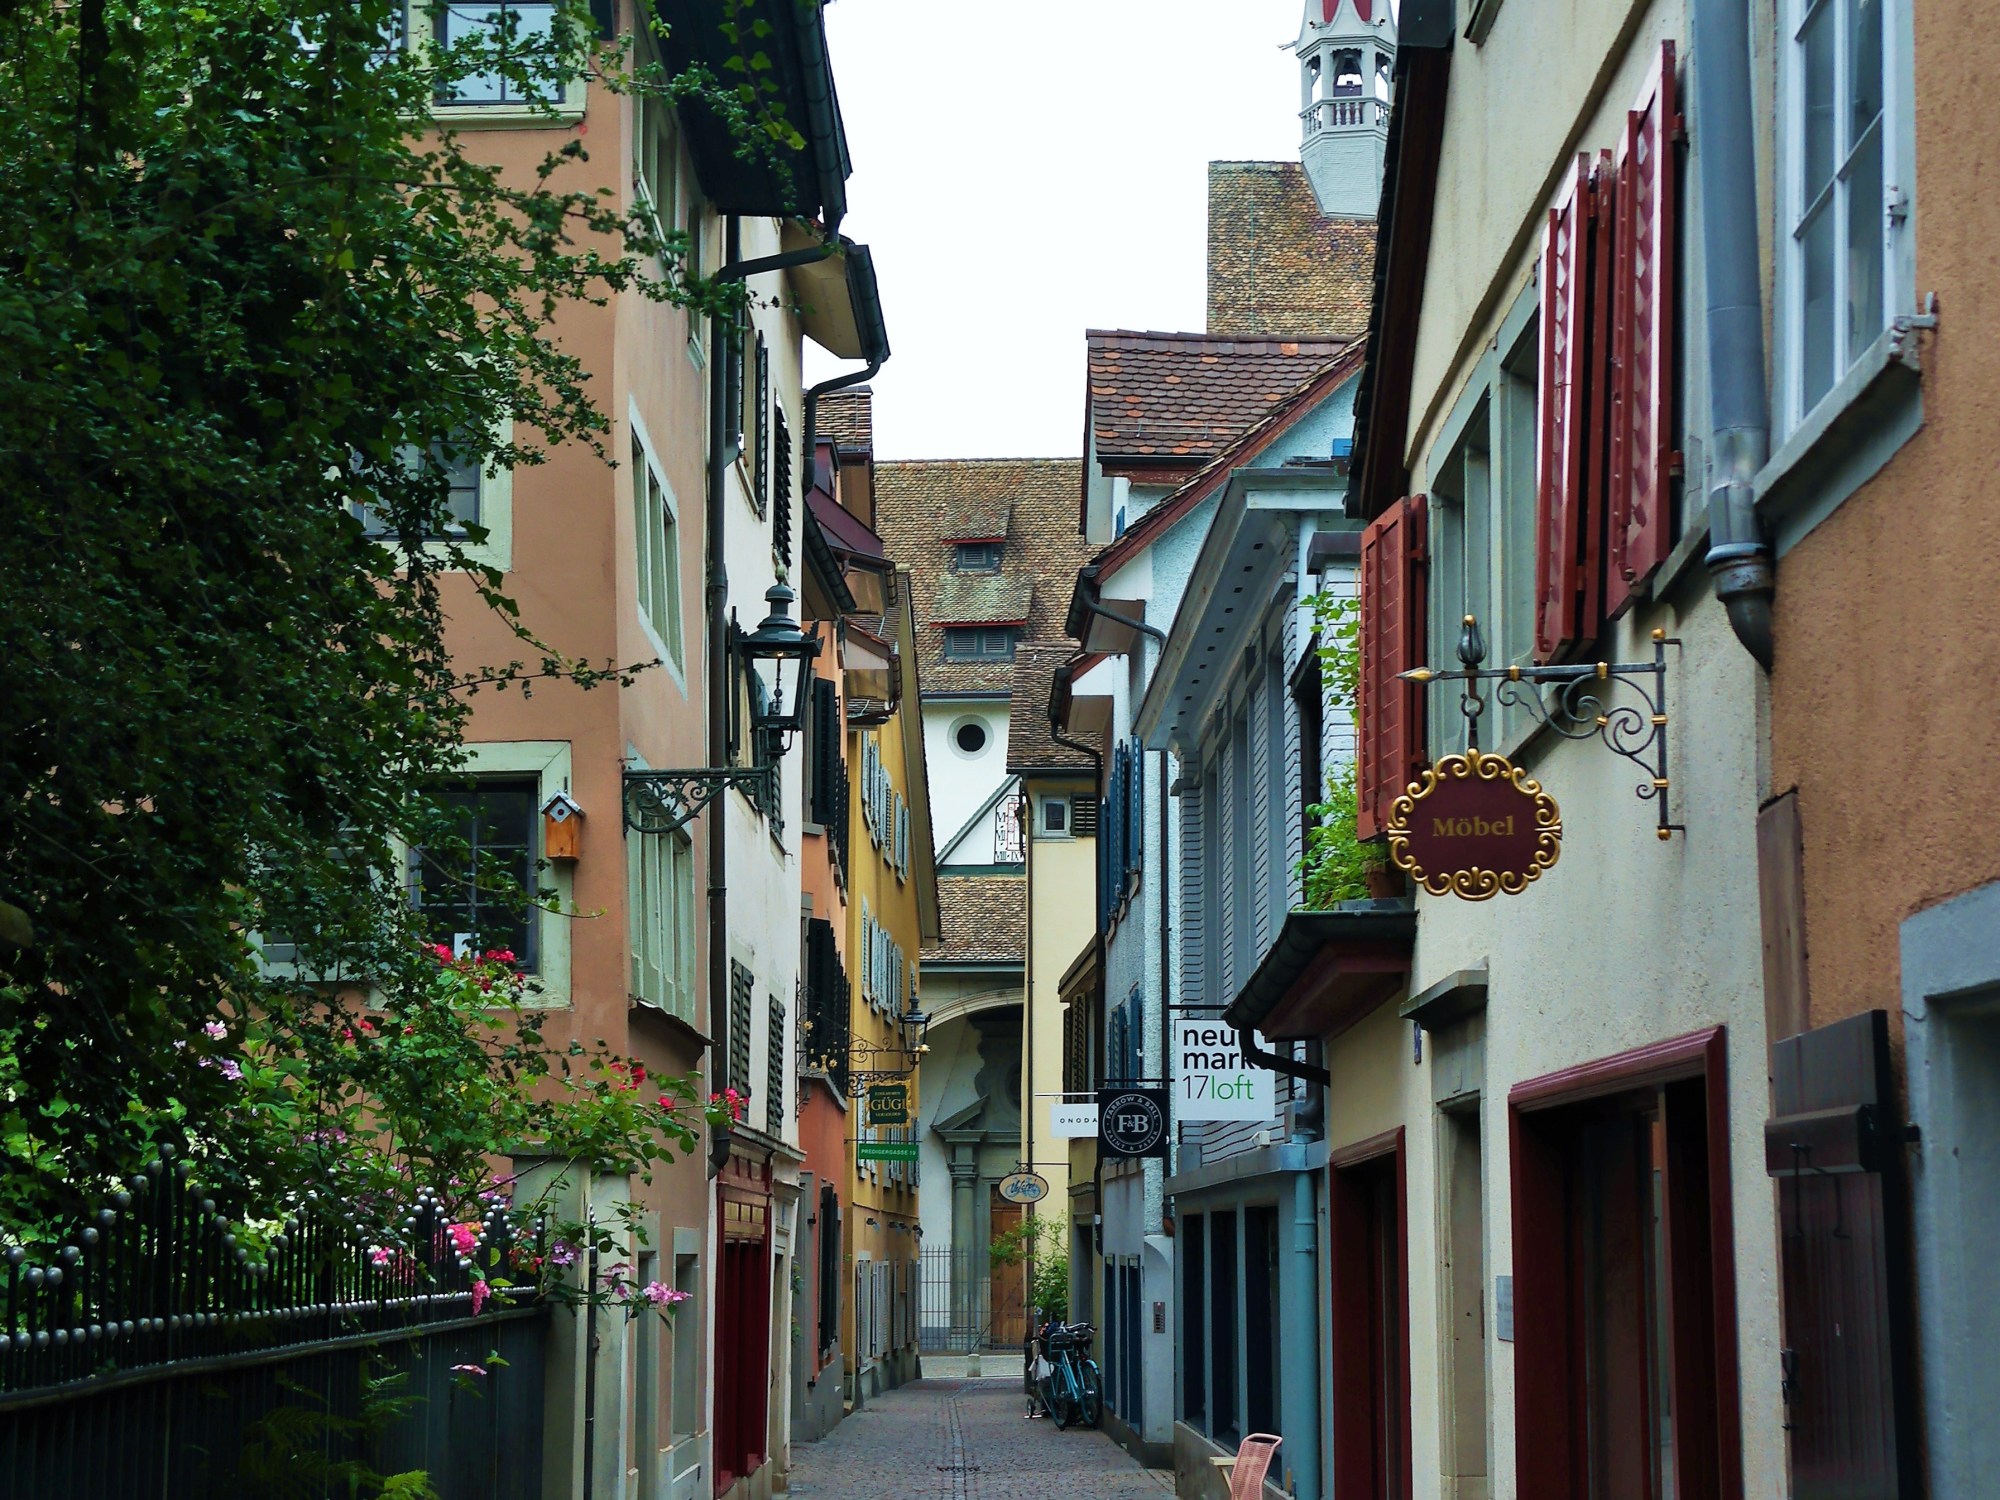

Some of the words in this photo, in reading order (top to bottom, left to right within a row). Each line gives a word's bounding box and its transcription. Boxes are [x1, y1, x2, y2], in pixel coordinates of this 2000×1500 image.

[1432, 815, 1515, 837] Möbel
[1183, 1029, 1236, 1046] neu
[1183, 1050, 1264, 1070] mark
[1105, 1096, 1135, 1119] FARROW
[1144, 1101, 1159, 1120] BALL
[1116, 1114, 1149, 1133] F&B
[1106, 1130, 1126, 1149] PAINT
[1138, 1131, 1158, 1149] PAPER
[860, 1148, 908, 1156] PREDIGERGASSE
